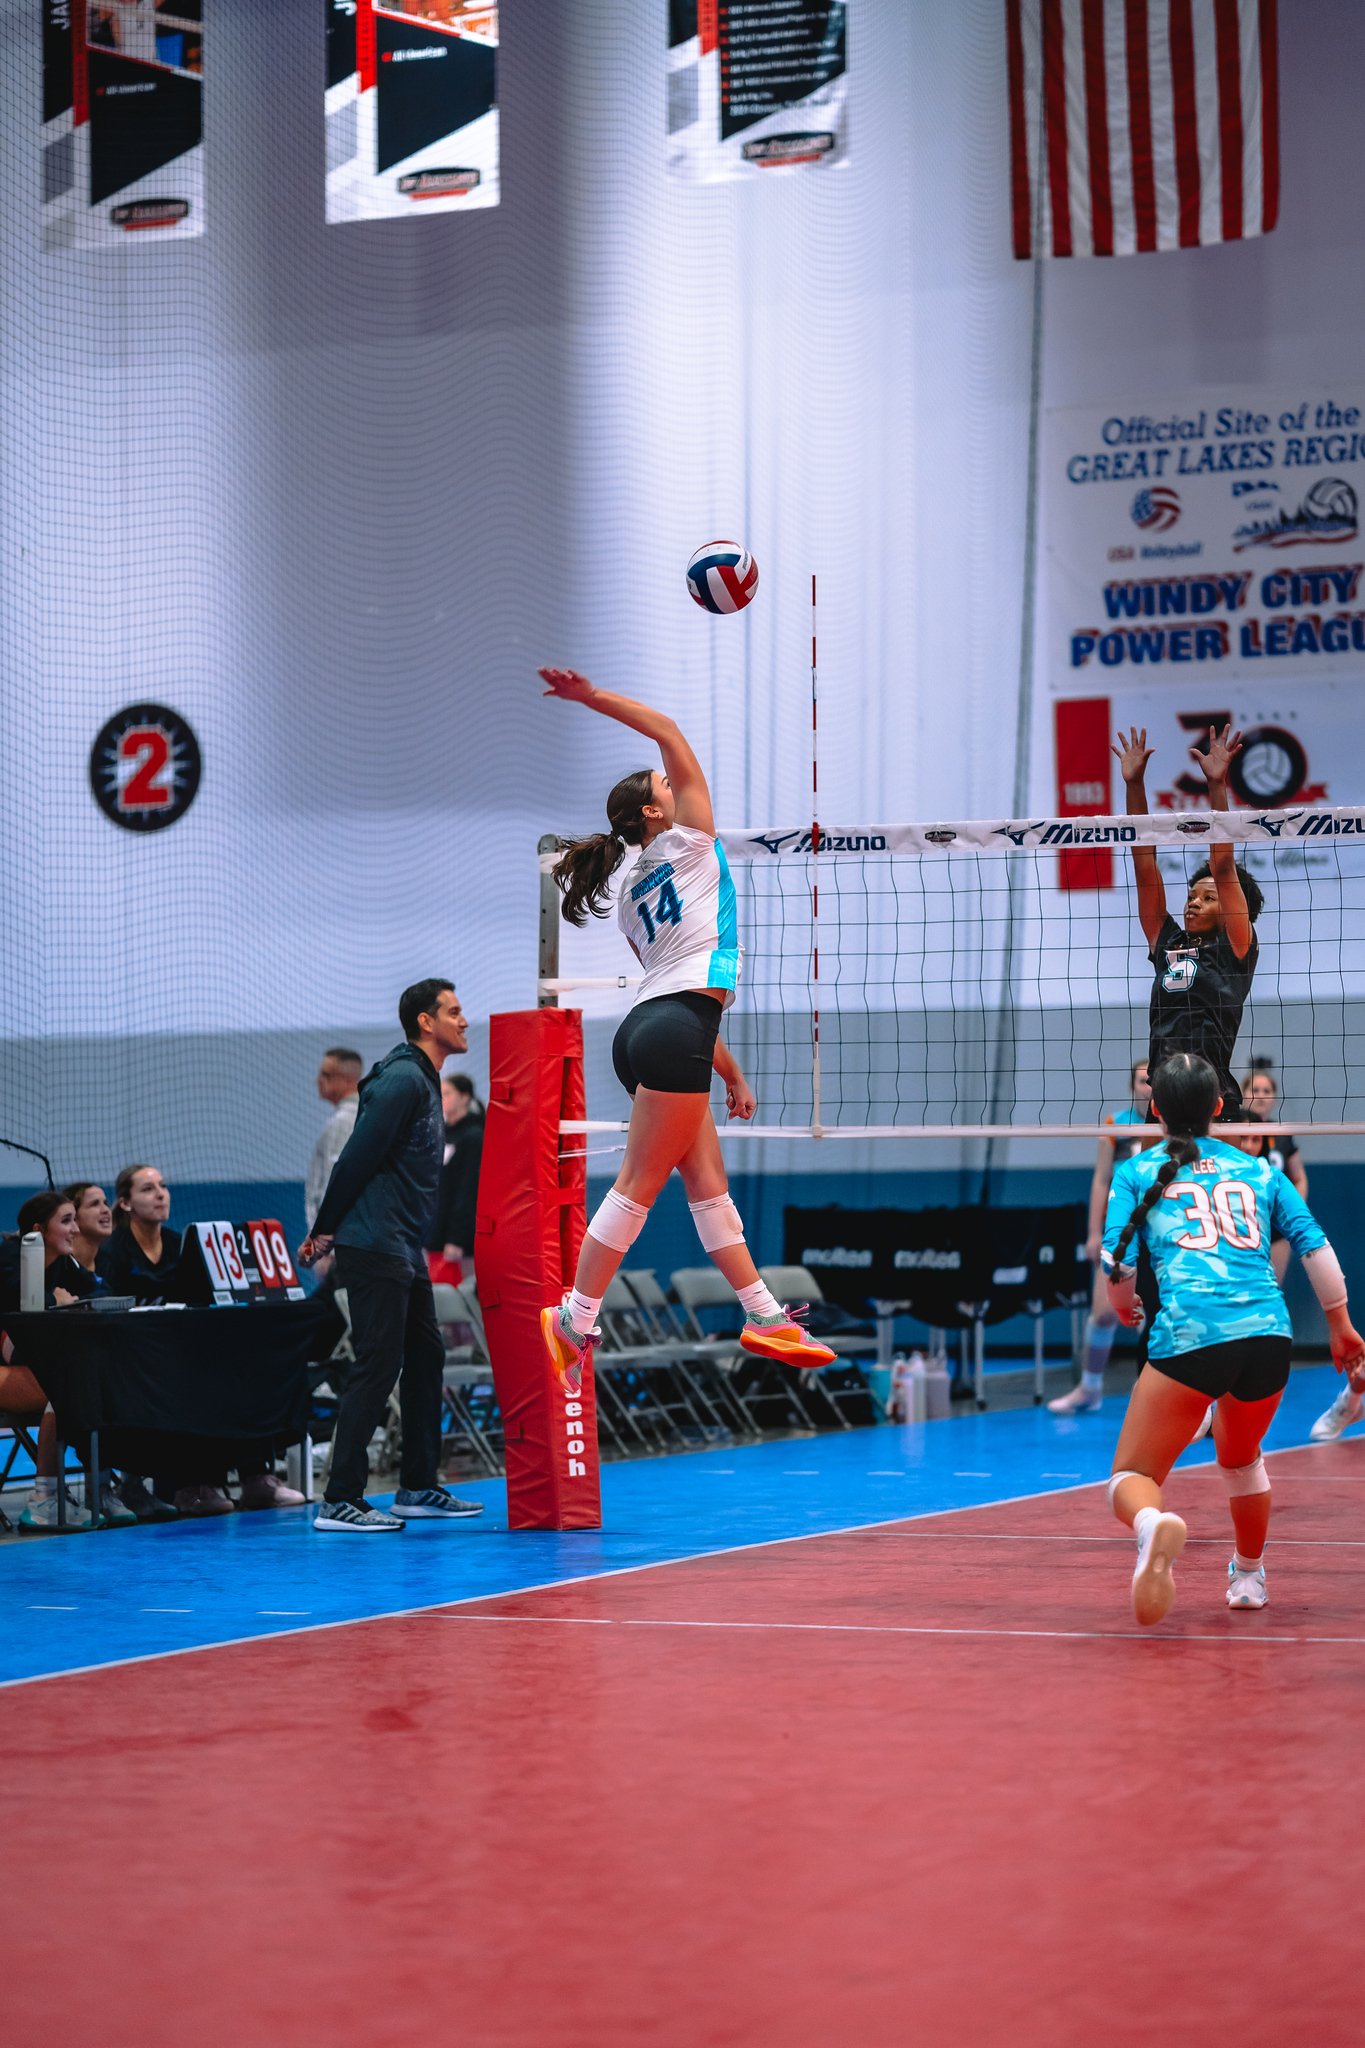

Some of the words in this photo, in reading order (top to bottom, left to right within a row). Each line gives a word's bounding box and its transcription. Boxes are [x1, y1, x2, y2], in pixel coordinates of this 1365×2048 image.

[1102, 411, 1206, 446] Official
[1214, 408, 1270, 438] Site
[1278, 402, 1308, 433] of
[1315, 400, 1361, 429] the
[1066, 448, 1170, 484] GREAT
[1177, 440, 1275, 475] LAKES
[1104, 570, 1252, 619] WINDY
[1261, 563, 1364, 609] CITY
[1070, 621, 1230, 668] POWER
[119, 729, 171, 808] 2
[636, 878, 684, 944] 14
[1162, 947, 1199, 993] 5
[1191, 1158, 1217, 1174] LEE
[1162, 1180, 1261, 1250] 30
[205, 1232, 243, 1281] 13
[237, 1230, 250, 1254] 2
[253, 1230, 293, 1281] 09
